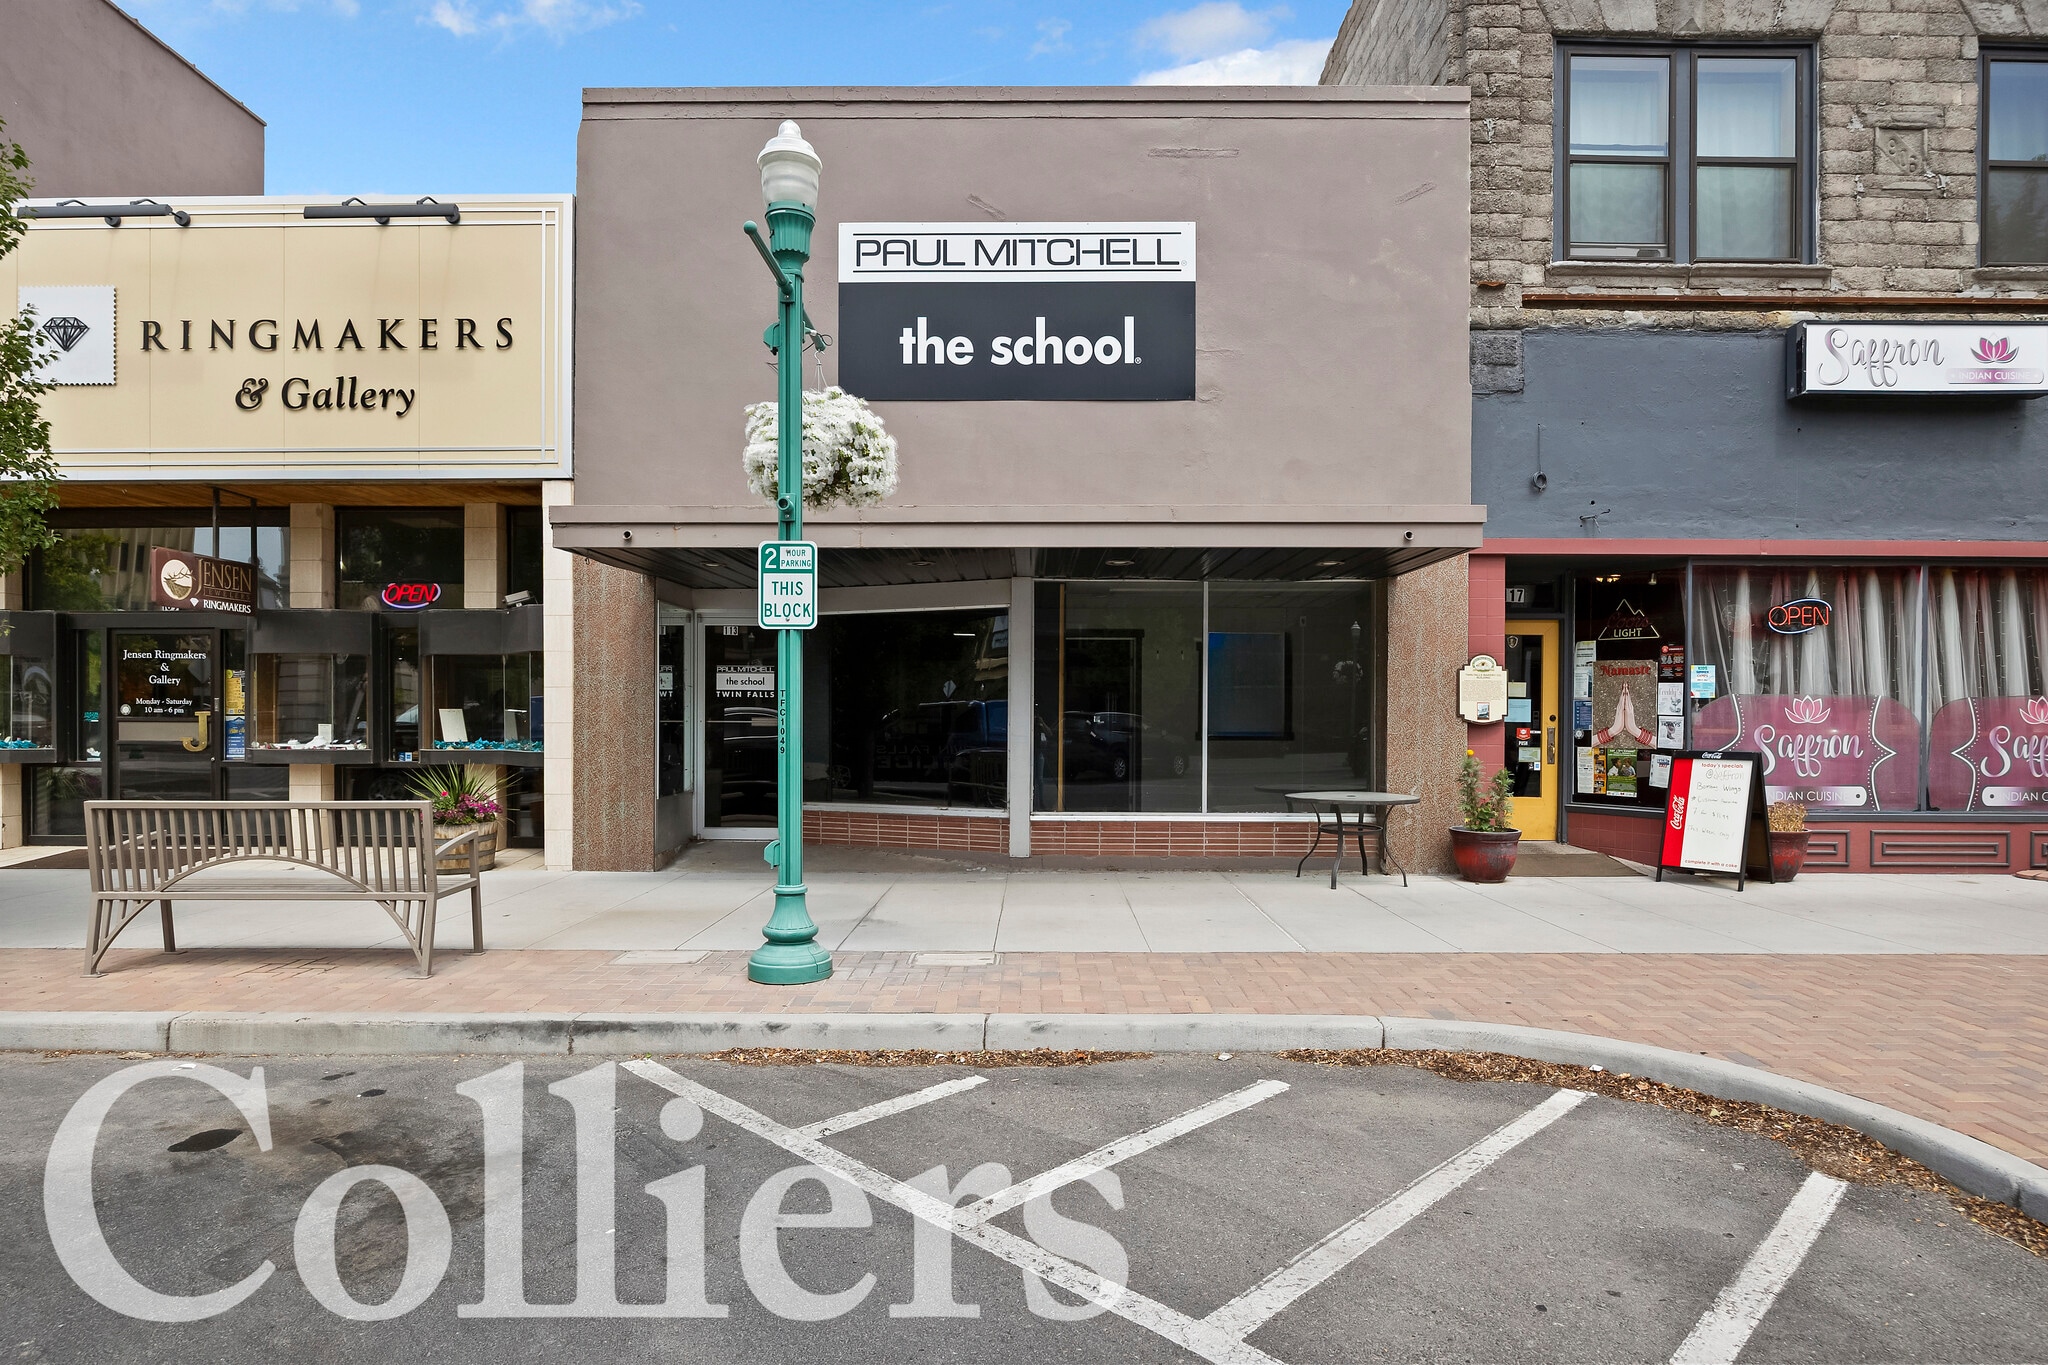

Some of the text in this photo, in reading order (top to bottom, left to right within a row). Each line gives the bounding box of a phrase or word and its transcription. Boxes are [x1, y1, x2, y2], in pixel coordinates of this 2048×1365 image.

[856, 238, 1180, 266] PAUL MITCHELL
[140, 317, 514, 352] RINGMAKERS
[899, 315, 1135, 365] the school
[1817, 327, 1945, 387] Saffron
[235, 375, 416, 418] & Gallery
[764, 547, 777, 569] 2
[786, 549, 806, 557] HOUR
[780, 559, 811, 567] PARKING
[195, 558, 251, 595] JENSEN
[385, 583, 436, 602] OPEN
[771, 581, 803, 596] THIS
[203, 600, 251, 614] RINGMAKERS
[764, 603, 811, 618] BLOCK
[1768, 605, 1829, 626] OPEN
[1613, 627, 1643, 638] LIGHT
[123, 649, 207, 661] Jensen Ringmakers
[160, 662, 170, 672] &
[716, 665, 775, 673] PAUL MITCHELL
[1599, 664, 1652, 677] Namaste
[148, 674, 181, 686] Gallery
[726, 676, 765, 685] the school
[135, 697, 161, 706] Monday
[165, 697, 193, 706] Saturday
[1753, 724, 1864, 777] Saffron
